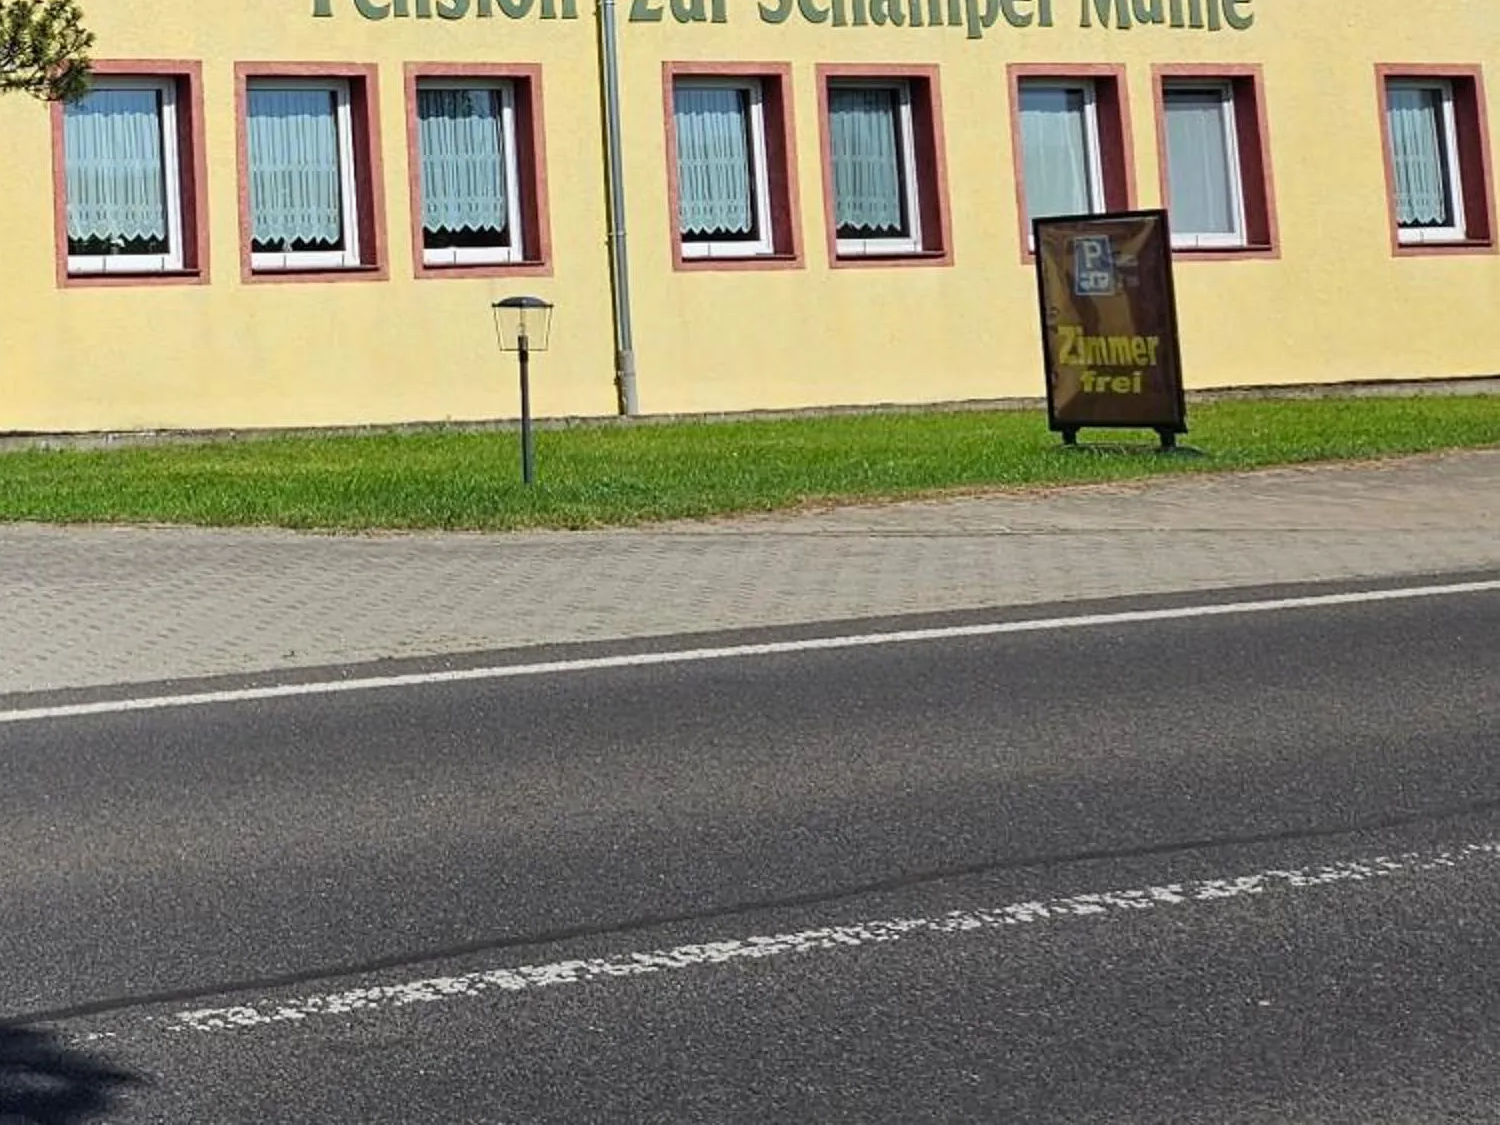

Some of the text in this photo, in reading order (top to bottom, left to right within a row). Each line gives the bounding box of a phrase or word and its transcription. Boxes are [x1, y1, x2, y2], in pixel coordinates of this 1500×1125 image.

[1083, 241, 1102, 268] P
[1057, 325, 1159, 366] Zimmer
[1080, 371, 1142, 393] frei
